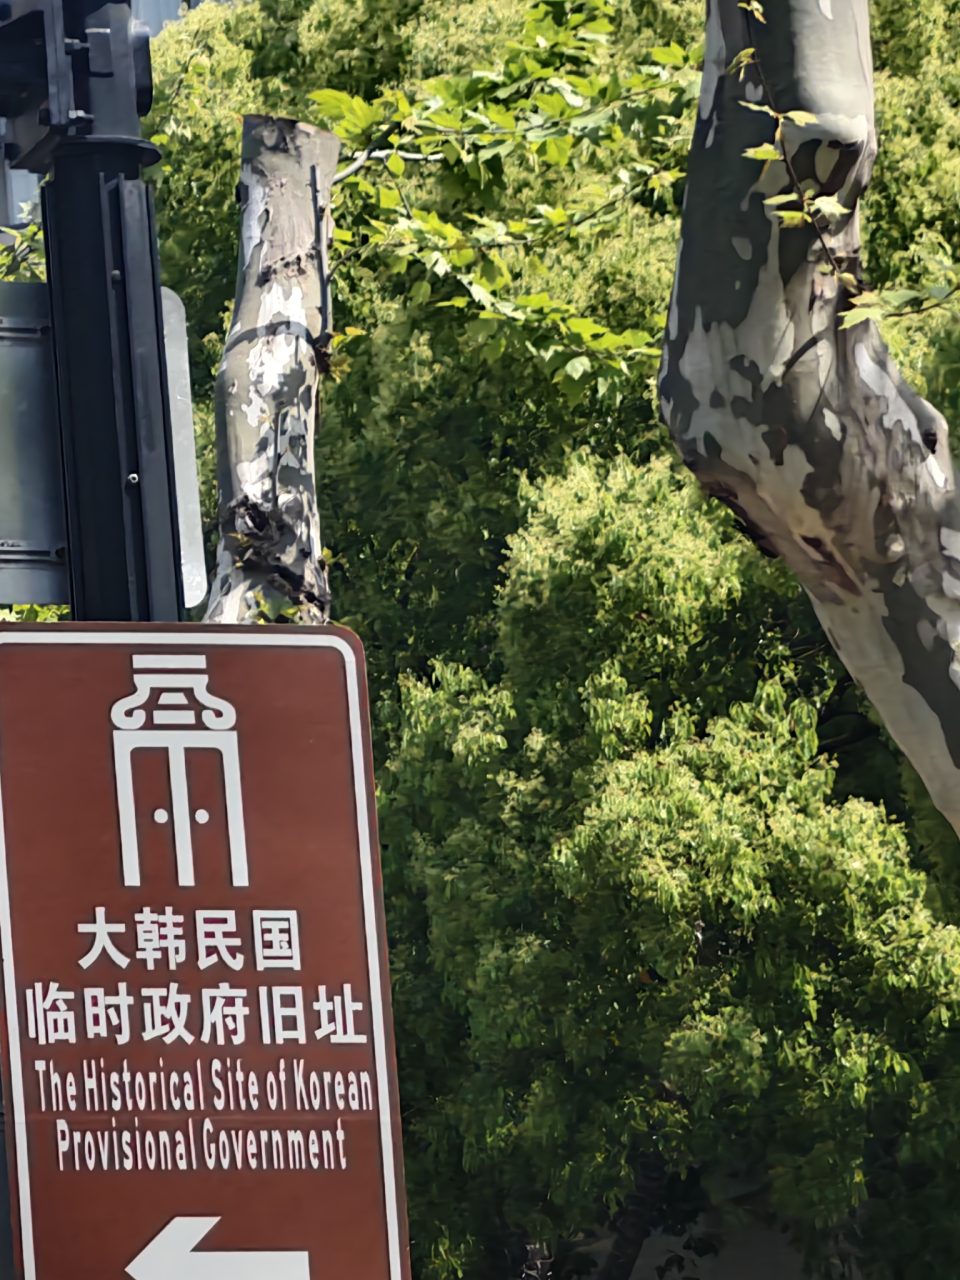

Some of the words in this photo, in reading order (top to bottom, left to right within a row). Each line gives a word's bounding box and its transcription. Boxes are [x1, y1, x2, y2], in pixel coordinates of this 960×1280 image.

[77, 906, 302, 971] 大韩民国
[25, 981, 368, 1046] 临时政府旧址
[34, 1059, 77, 1112] The
[83, 1057, 205, 1112] Historical
[211, 1057, 259, 1111] Site
[266, 1058, 287, 1111] of
[293, 1058, 373, 1111] Korean
[56, 1116, 197, 1171] Provisional
[202, 1117, 347, 1170] Government
